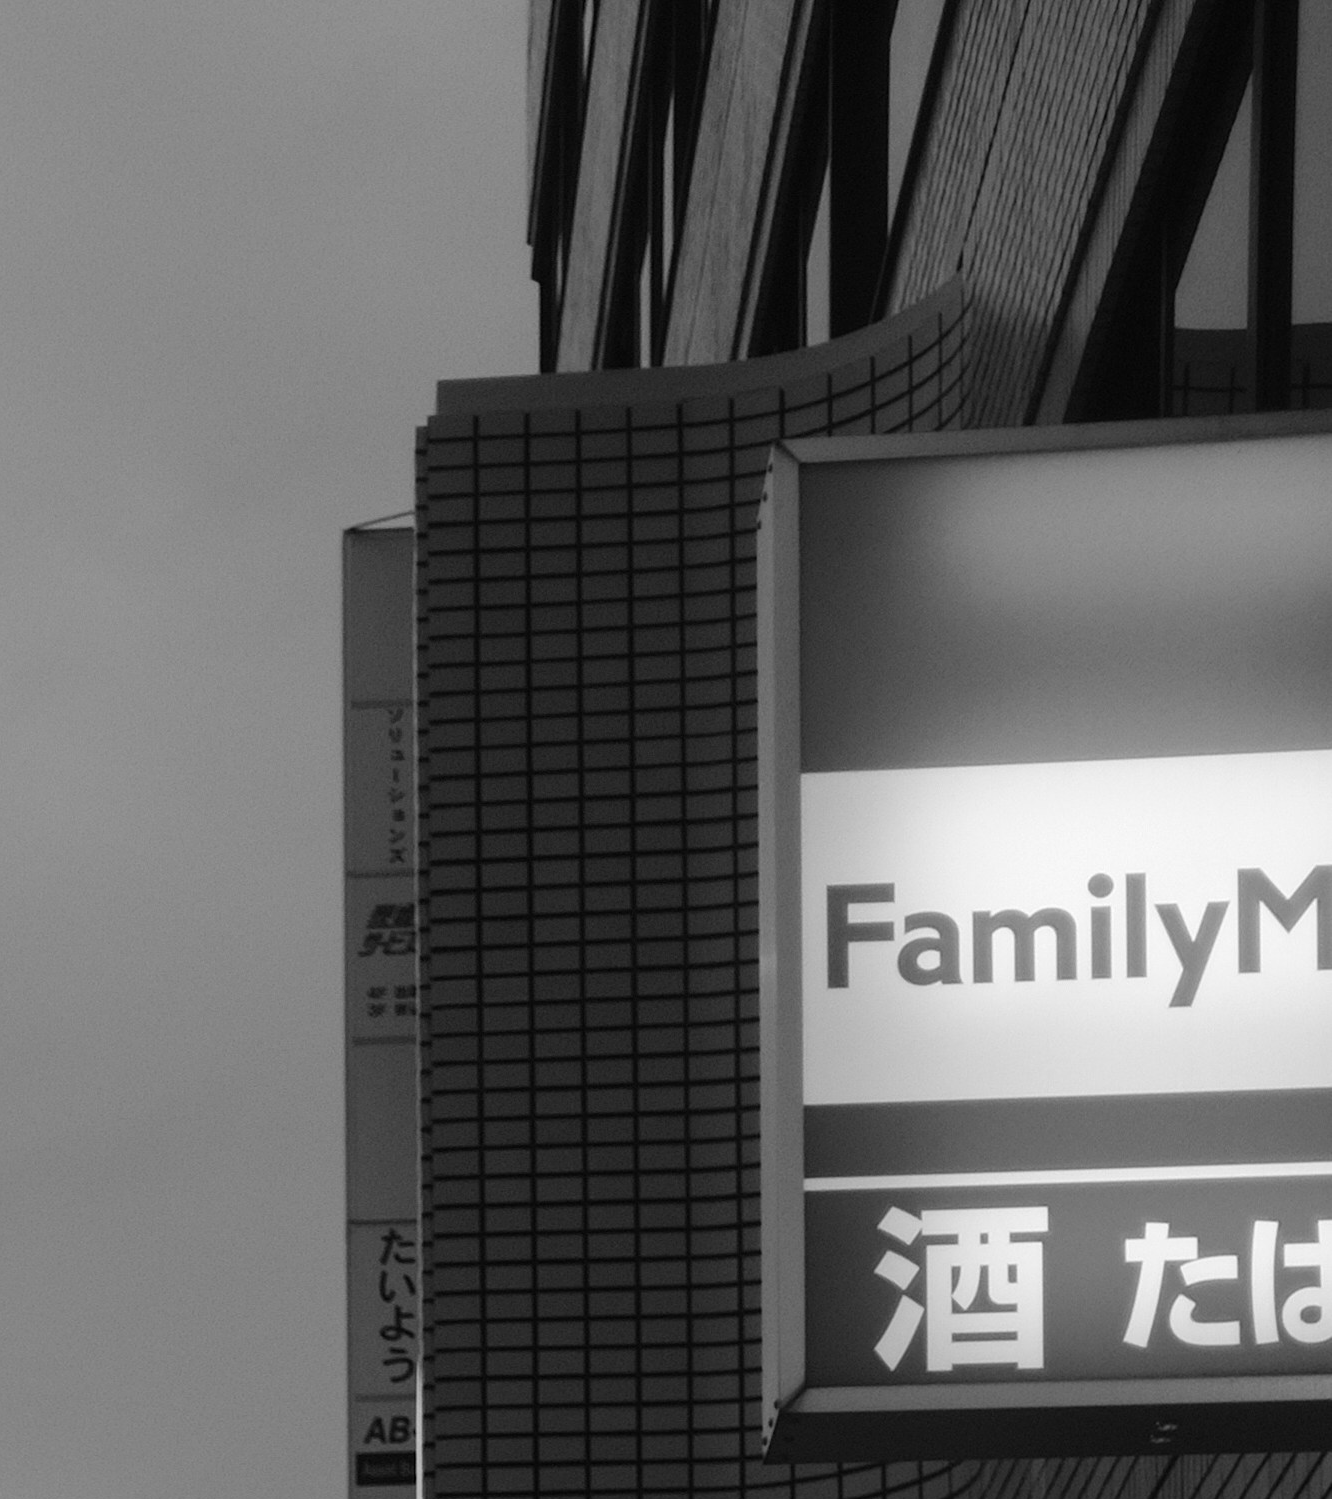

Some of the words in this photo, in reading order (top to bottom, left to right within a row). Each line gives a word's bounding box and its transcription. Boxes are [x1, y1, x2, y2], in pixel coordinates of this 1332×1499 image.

[825, 863, 1332, 1008] FamilyM
[380, 1229, 415, 1384] たいよう
[873, 1206, 1050, 1373] 酒
[363, 1416, 415, 1445] AB
